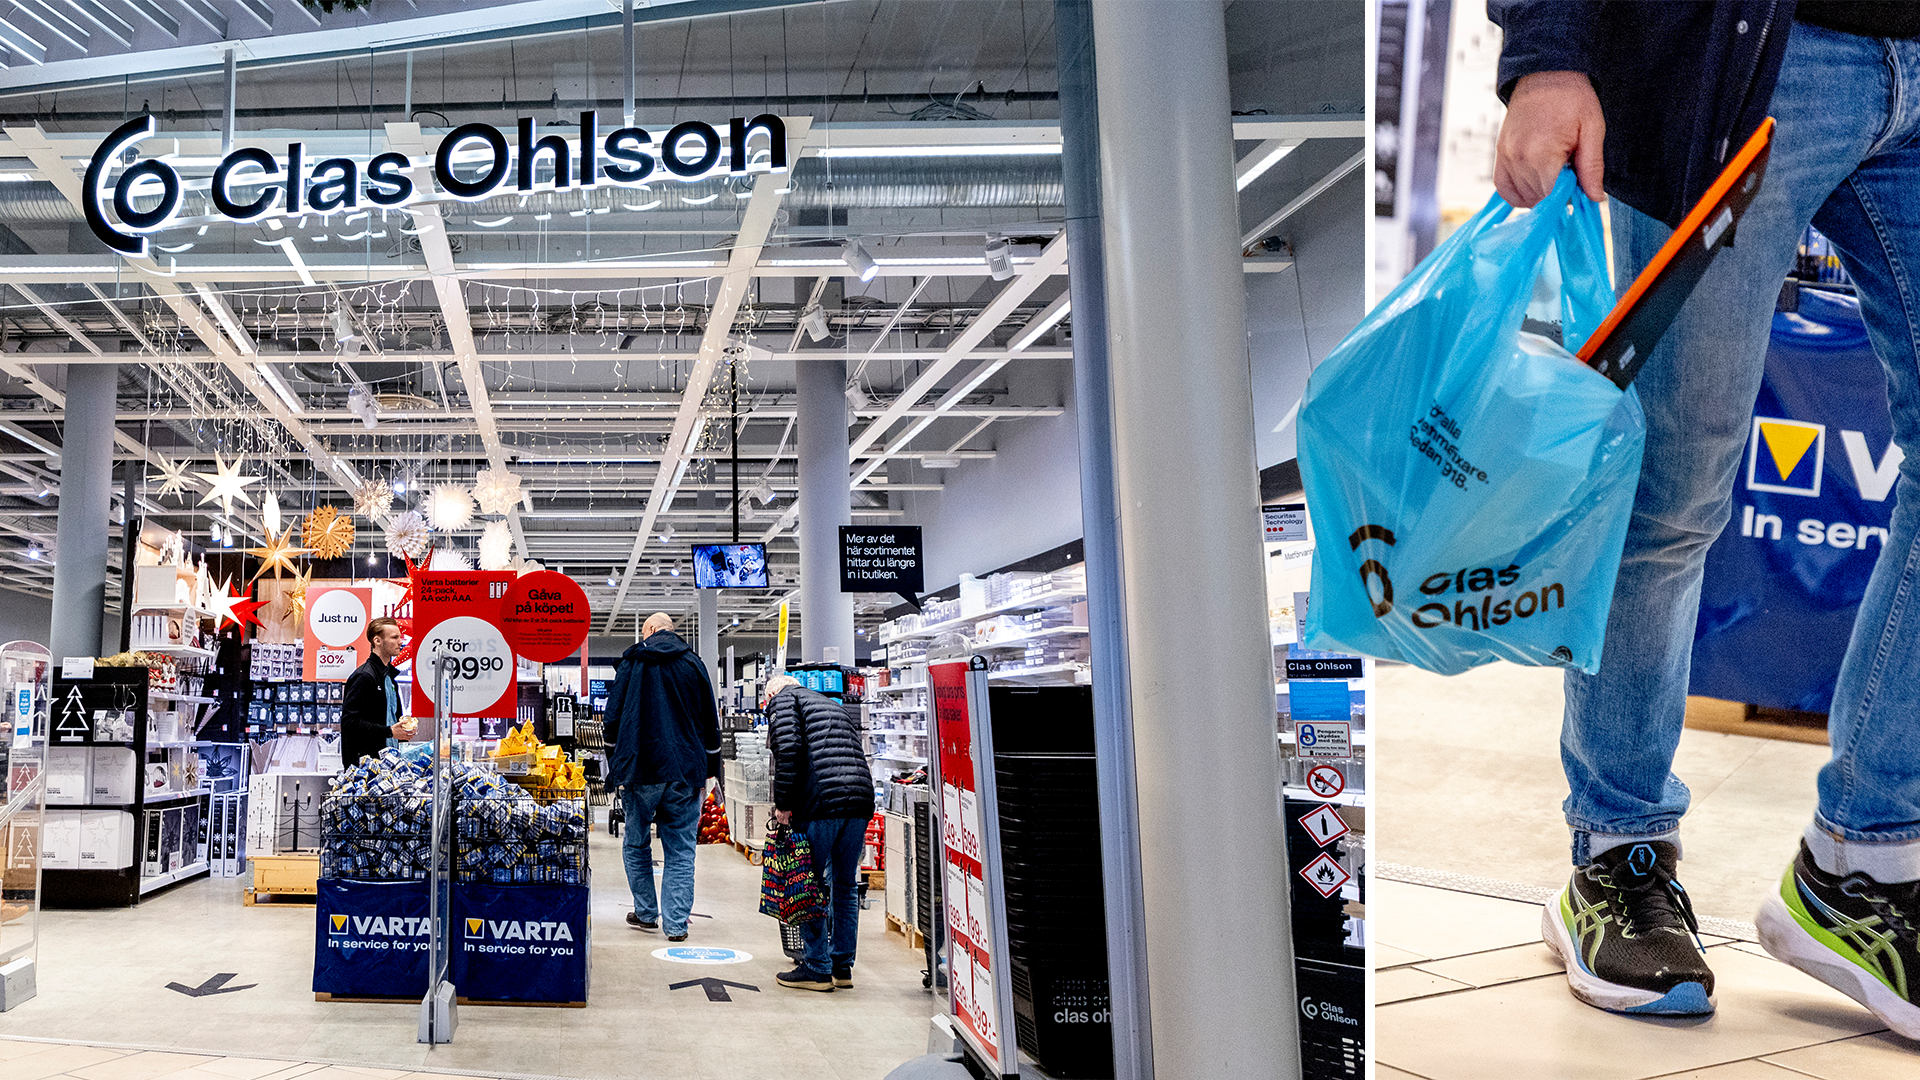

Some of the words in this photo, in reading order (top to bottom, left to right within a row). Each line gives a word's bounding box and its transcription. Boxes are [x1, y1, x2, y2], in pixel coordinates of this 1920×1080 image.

[211, 142, 414, 220] Clas
[434, 109, 789, 198] Ohlson
[1440, 416, 1462, 440] alla
[1742, 505, 1783, 541] In
[846, 534, 865, 544] Mer
[866, 535, 878, 544] av
[880, 534, 895, 544] det
[846, 546, 862, 556] här
[863, 546, 916, 556] sortimentet
[1284, 548, 1314, 561] Matförvarin
[846, 558, 871, 568] hittar
[872, 558, 885, 567] du
[886, 558, 916, 570] längre
[847, 570, 856, 579] in
[862, 570, 899, 580] butiken.
[1419, 564, 1521, 596] Clas
[420, 587, 457, 595] 24-pack,
[528, 588, 562, 600] Gåva
[515, 601, 532, 615] på
[534, 602, 574, 615] köpet!
[1411, 582, 1565, 632] Ohlson
[318, 613, 341, 623] Just
[343, 615, 358, 623] nu
[445, 638, 469, 652] för
[319, 654, 345, 664] 30%
[1288, 662, 1312, 671] Clas
[1315, 661, 1353, 671] Ohlson
[352, 915, 432, 937] VARTA
[488, 920, 574, 942] VARTA
[328, 938, 339, 948] In
[342, 940, 390, 949] service
[392, 940, 411, 950] for
[464, 942, 475, 952] In
[478, 944, 526, 954] service
[528, 945, 548, 955] for
[550, 947, 574, 957] you
[1320, 1001, 1344, 1014] Clas
[1053, 1007, 1089, 1024] clas
[1321, 1010, 1358, 1026] Ohlson
